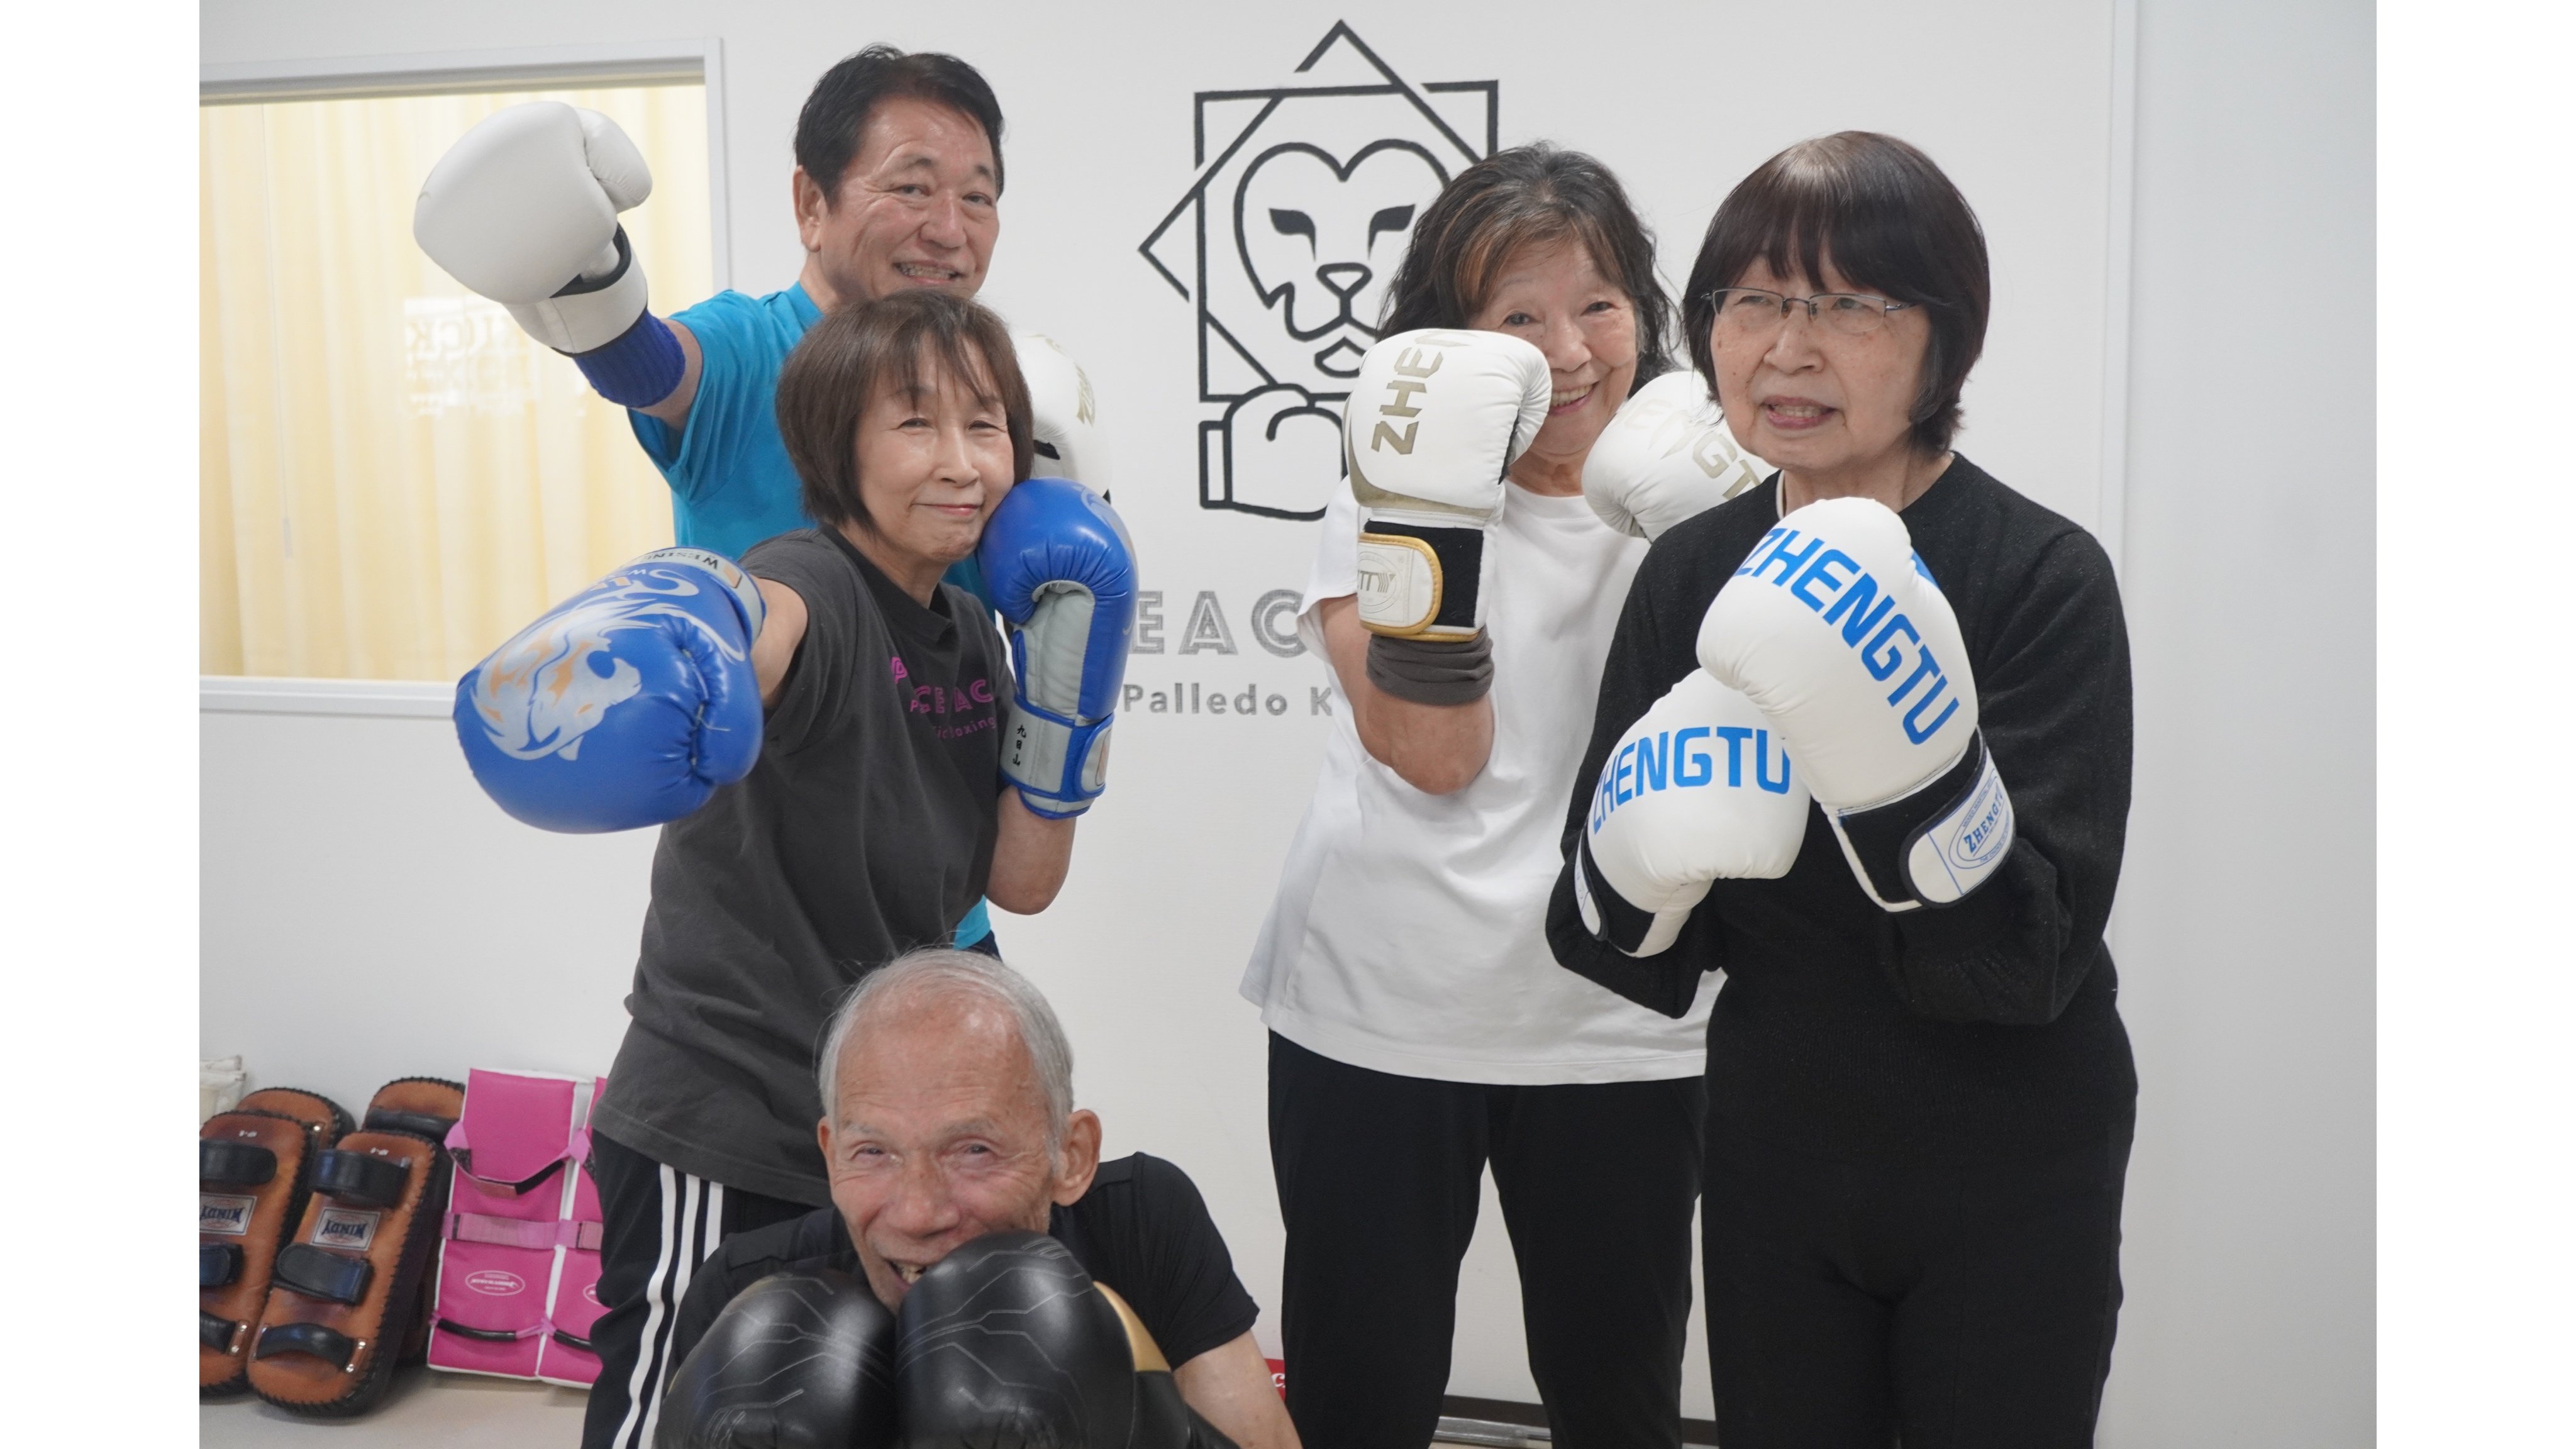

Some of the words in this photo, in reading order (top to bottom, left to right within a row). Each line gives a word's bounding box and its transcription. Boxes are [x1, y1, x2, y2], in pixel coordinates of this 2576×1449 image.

[1732, 527, 1960, 746] ZHENGTU
[1123, 682, 1288, 716] Palledo
[1593, 726, 1790, 835] ZHENGTU
[321, 1219, 370, 1240] WINDY
